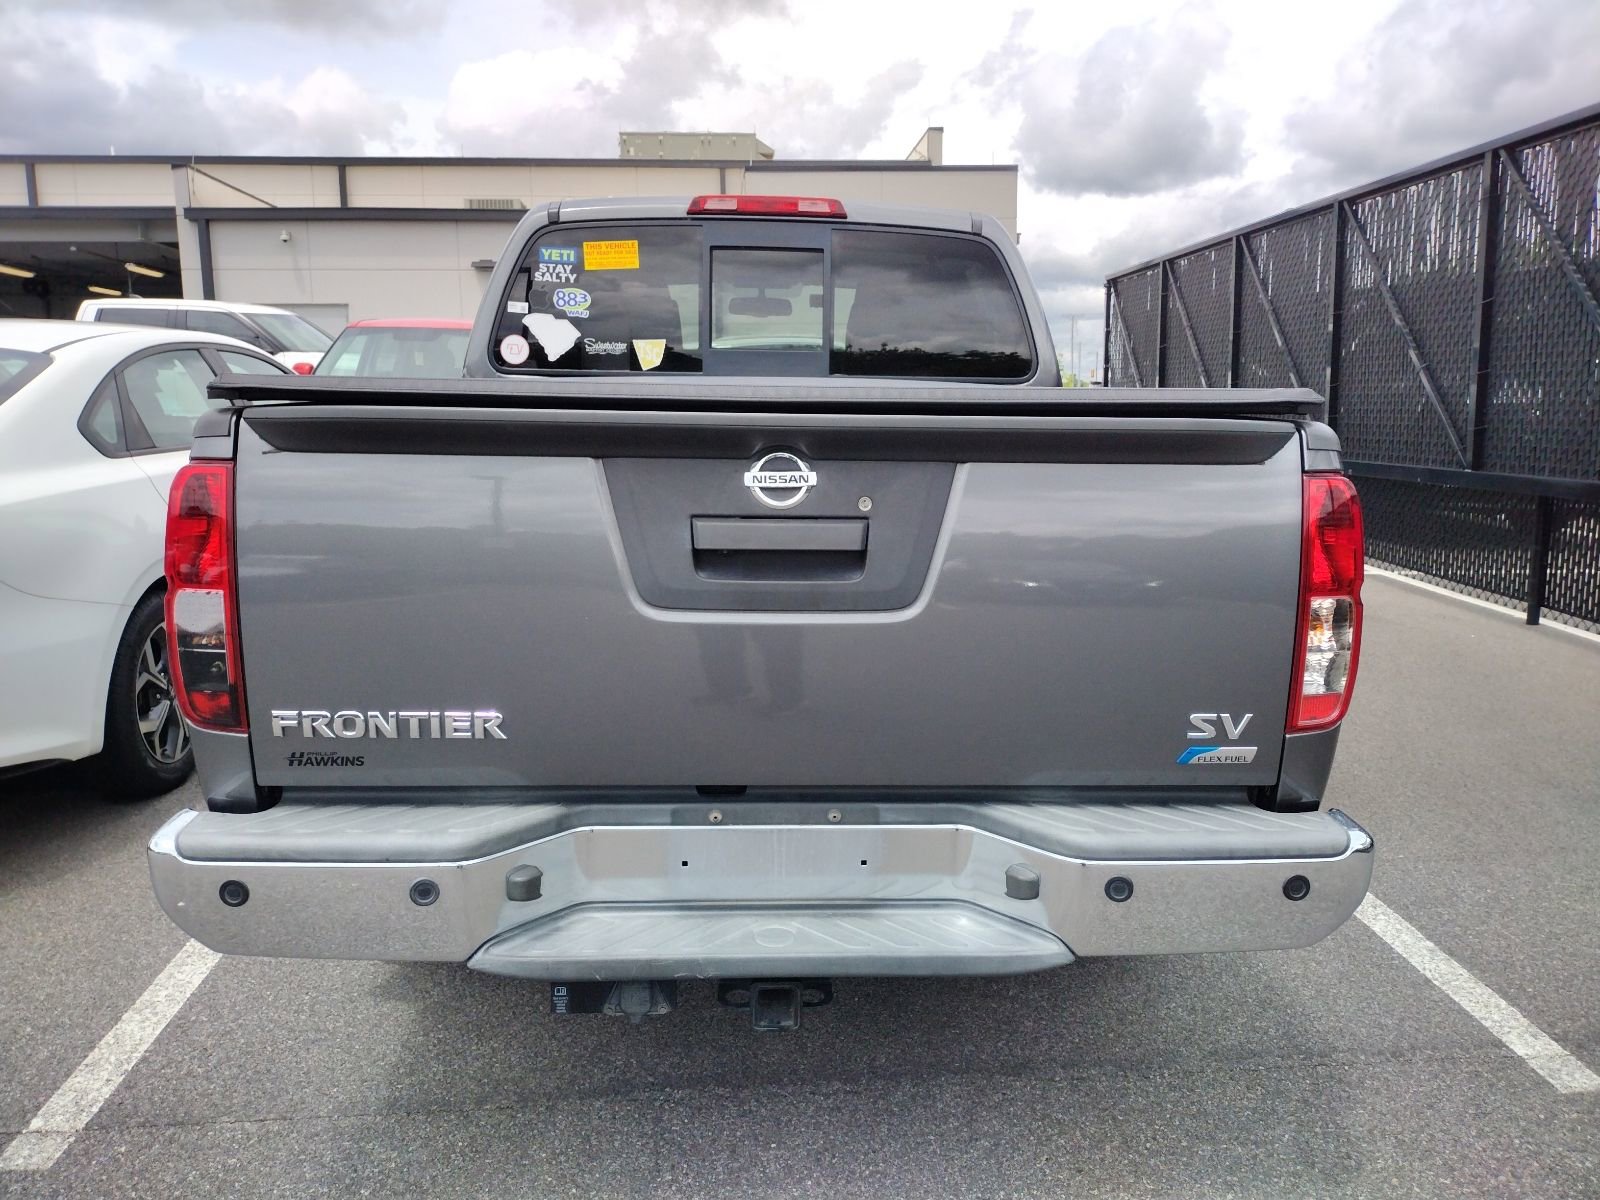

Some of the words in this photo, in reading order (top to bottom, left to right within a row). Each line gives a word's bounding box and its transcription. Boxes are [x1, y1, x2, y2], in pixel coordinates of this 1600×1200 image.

[605, 241, 637, 249] VEHICLE
[541, 248, 575, 261] YETI
[539, 263, 573, 274] STAY
[534, 271, 577, 283] SALTY
[556, 290, 588, 308] 88.3
[583, 337, 628, 350] Sweetwater
[752, 475, 809, 484] NISSAN
[271, 710, 507, 739] FRONTIER
[1186, 713, 1253, 739] SV
[287, 752, 365, 767] HAWKINS
